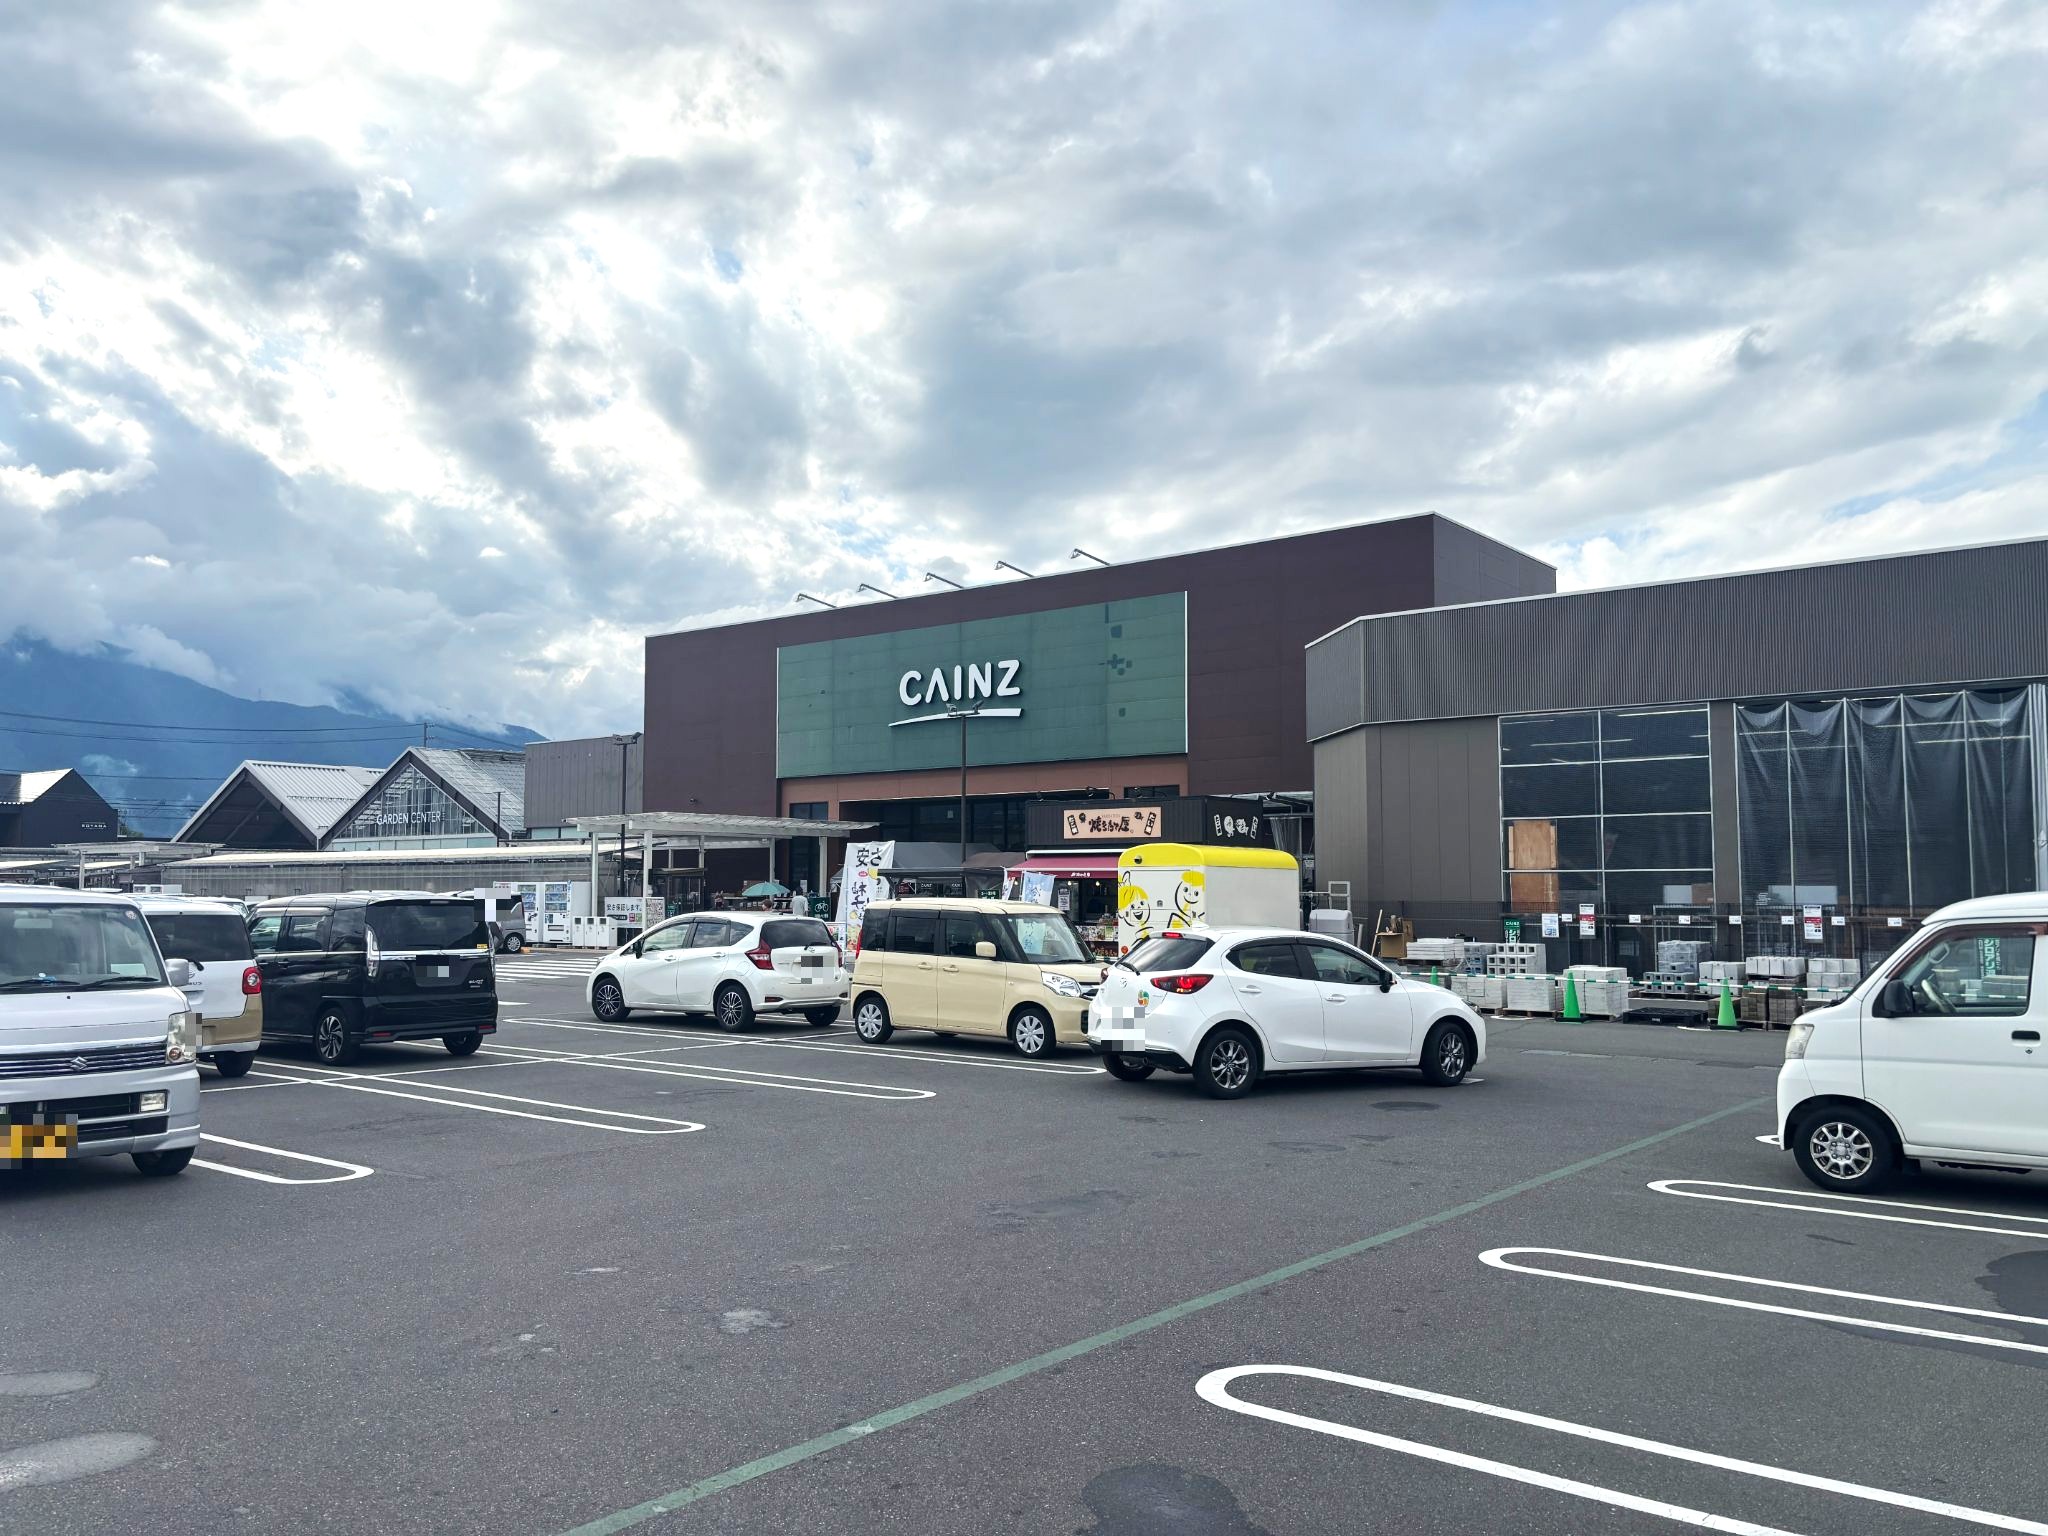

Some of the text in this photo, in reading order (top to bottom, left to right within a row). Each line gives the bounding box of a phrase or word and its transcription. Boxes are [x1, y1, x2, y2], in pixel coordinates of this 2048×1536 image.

[899, 659, 1021, 706] CAINZ
[376, 811, 441, 825] GARDEN CENTER
[856, 847, 882, 867] 安さ
